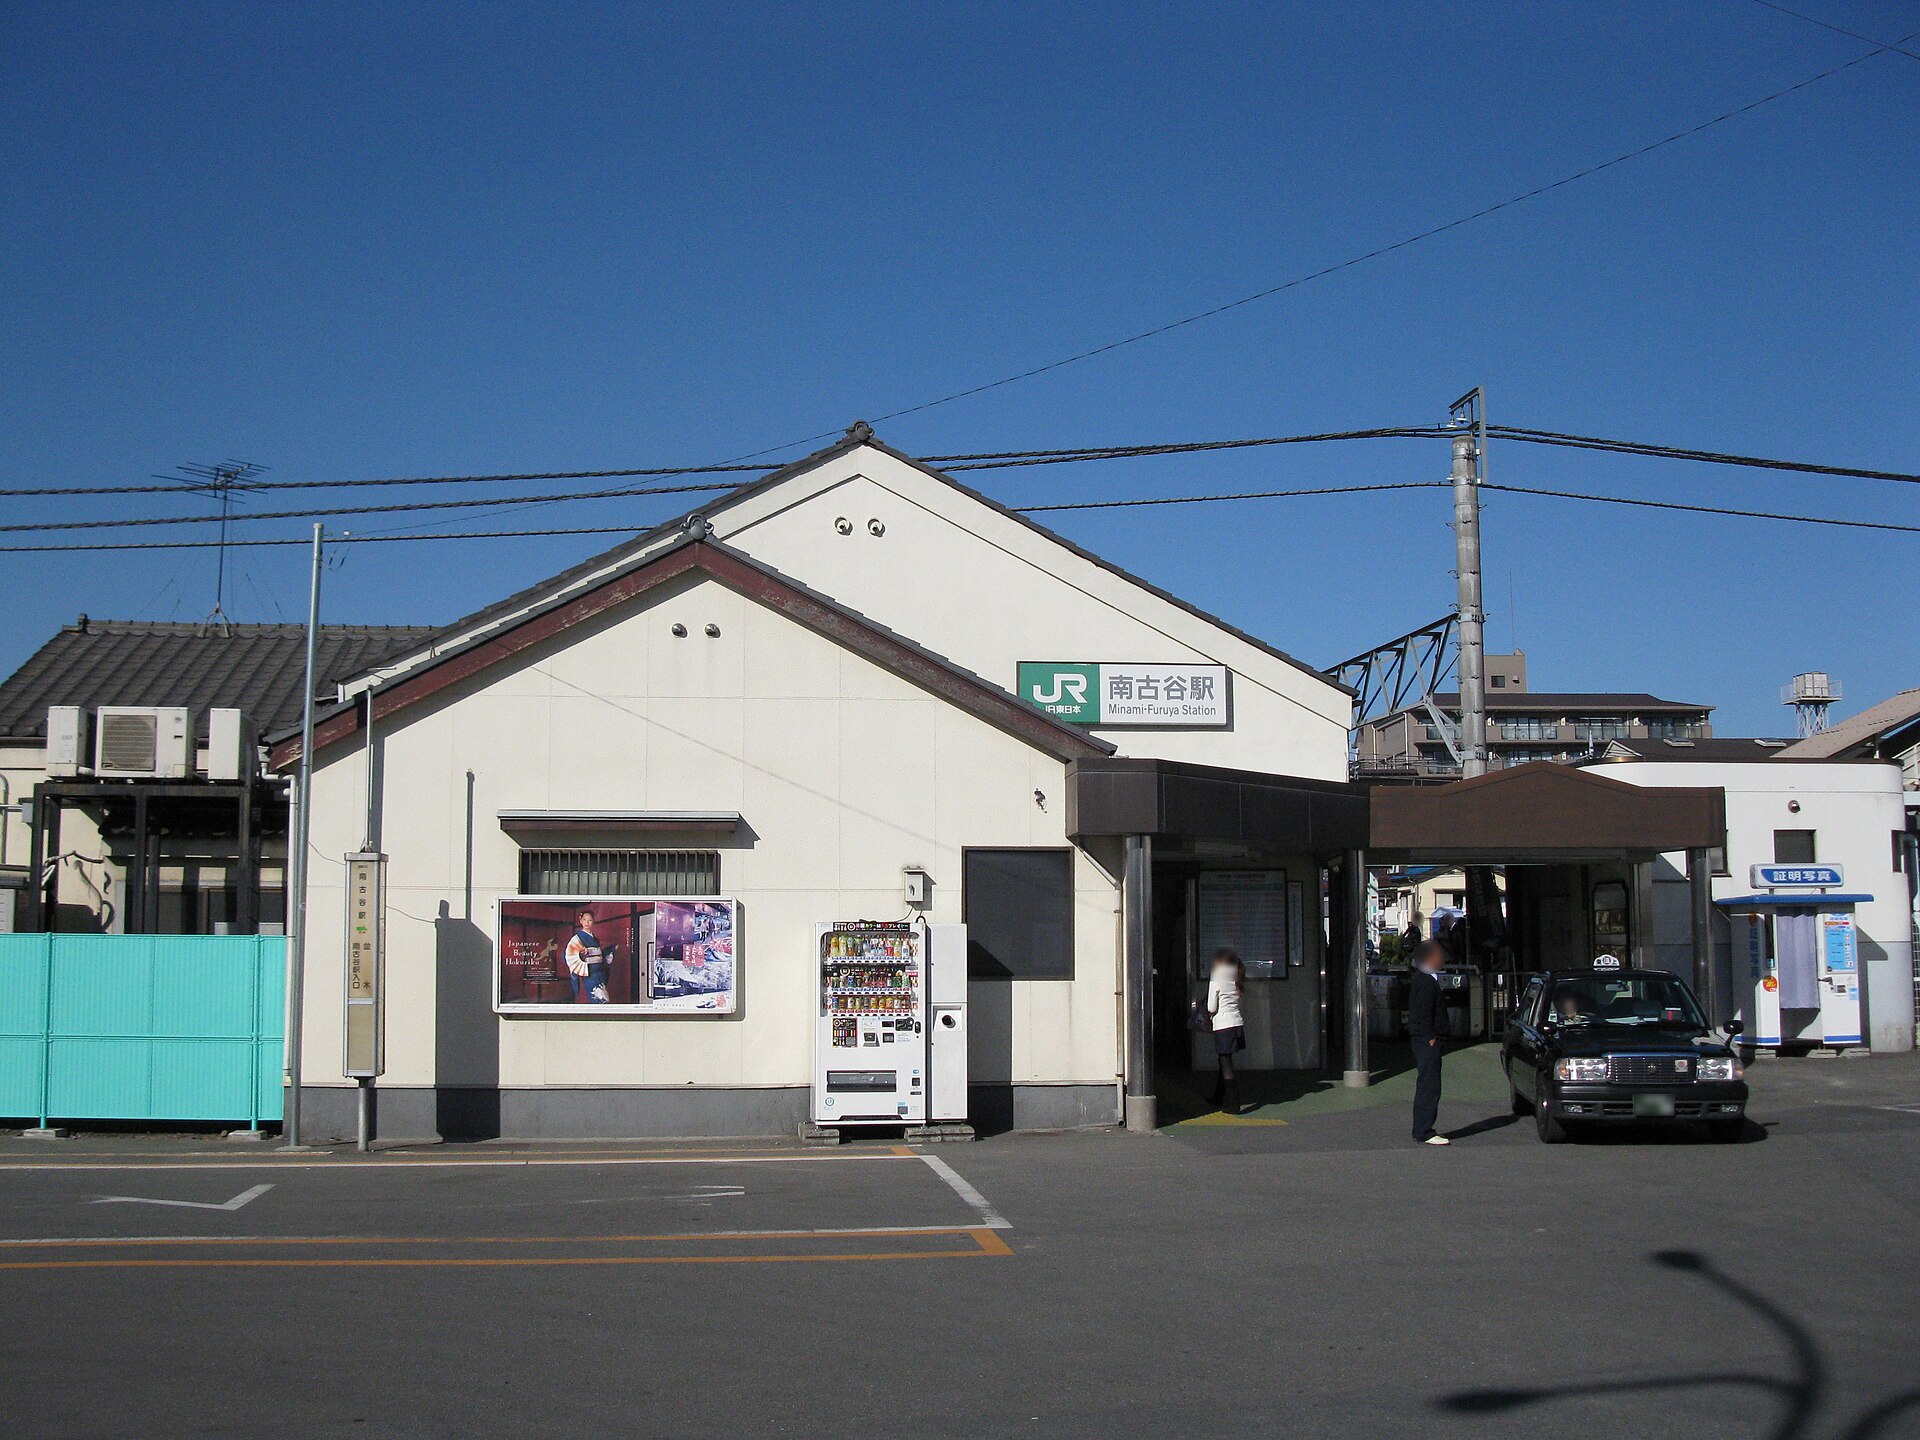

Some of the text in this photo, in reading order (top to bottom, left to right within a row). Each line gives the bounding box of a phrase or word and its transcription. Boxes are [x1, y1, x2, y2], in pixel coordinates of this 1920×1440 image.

[1033, 673, 1088, 704] JR
[1108, 675, 1215, 701] 南古谷駅
[1108, 703, 1216, 717] Minami-Furuya Station
[1773, 870, 1831, 882] 証明写真
[358, 873, 367, 919] 南古谷駅
[508, 939, 540, 948] Japanese
[513, 949, 538, 959] Beauty
[505, 957, 541, 966] Hokuriku
